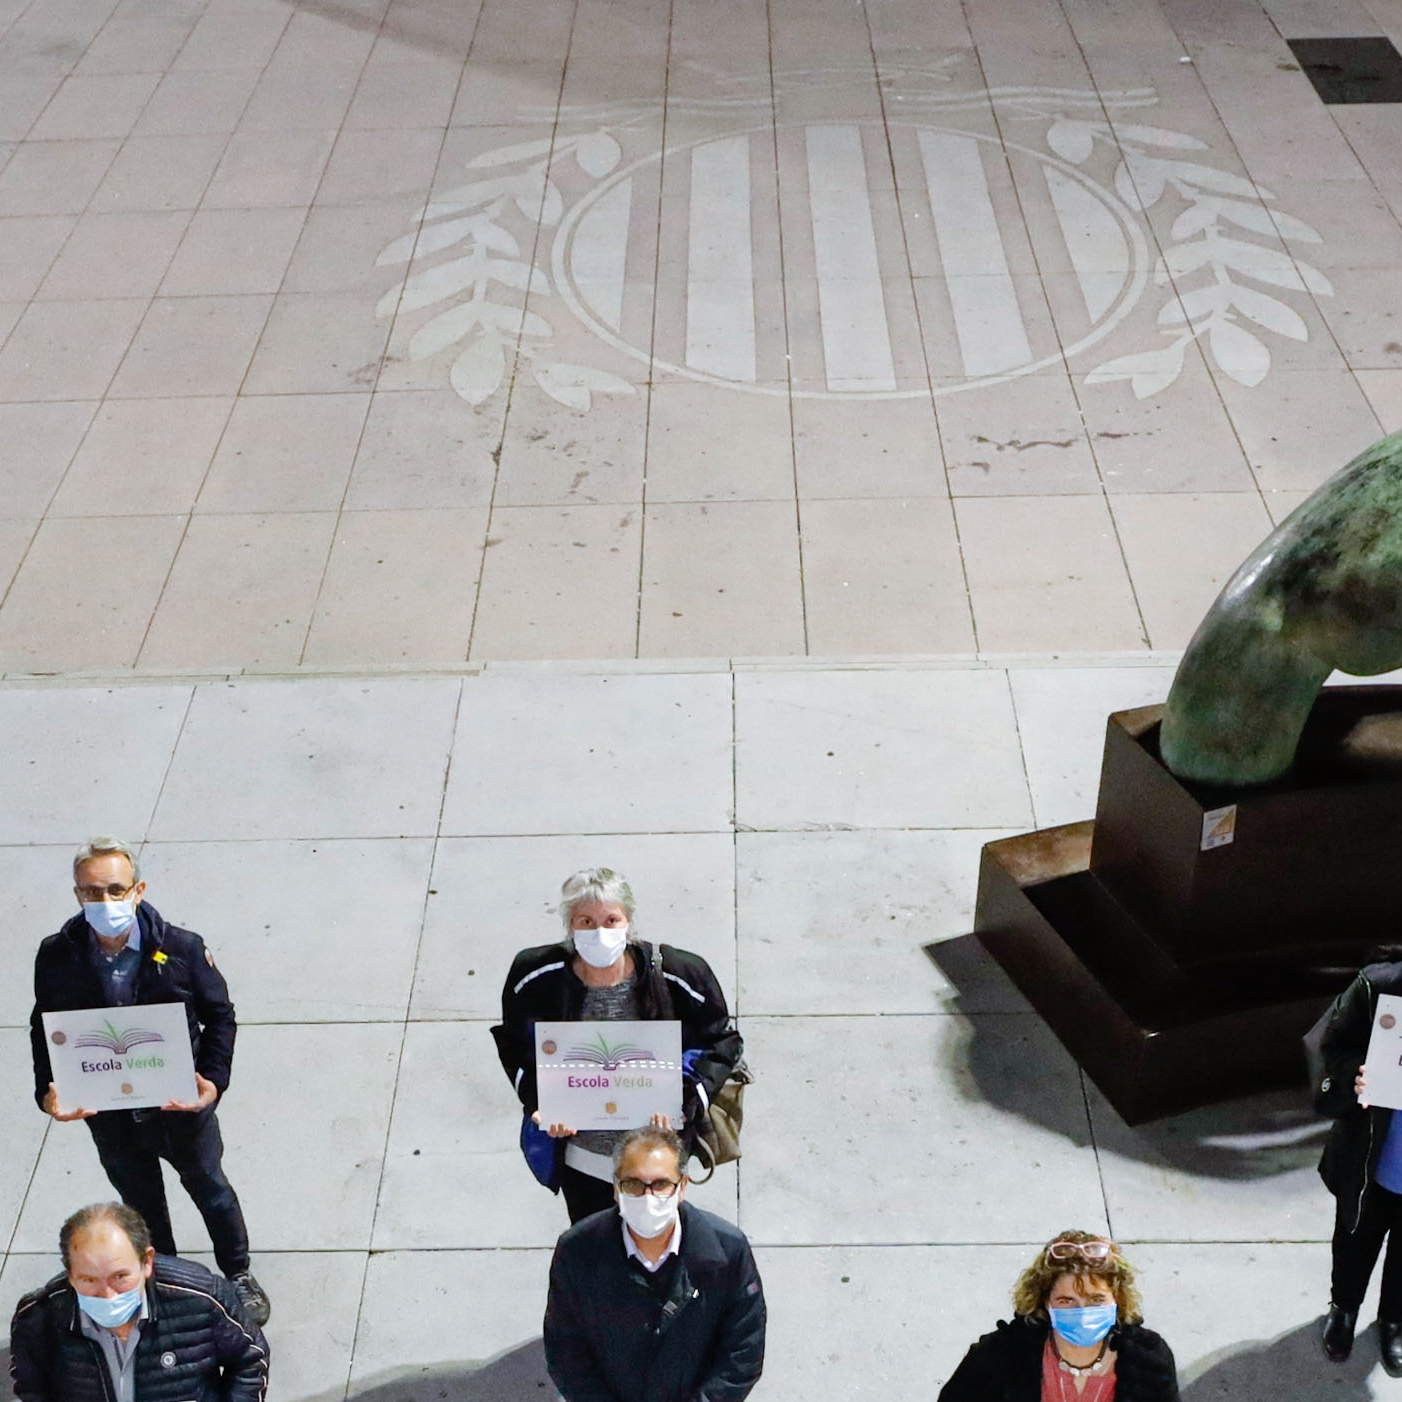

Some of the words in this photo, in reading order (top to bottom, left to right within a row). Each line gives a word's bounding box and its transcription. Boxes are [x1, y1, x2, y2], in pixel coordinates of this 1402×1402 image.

[82, 1059, 122, 1073] Escola
[126, 1057, 165, 1070] Verda
[567, 1075, 609, 1088] Escola
[614, 1075, 653, 1088] Verda
